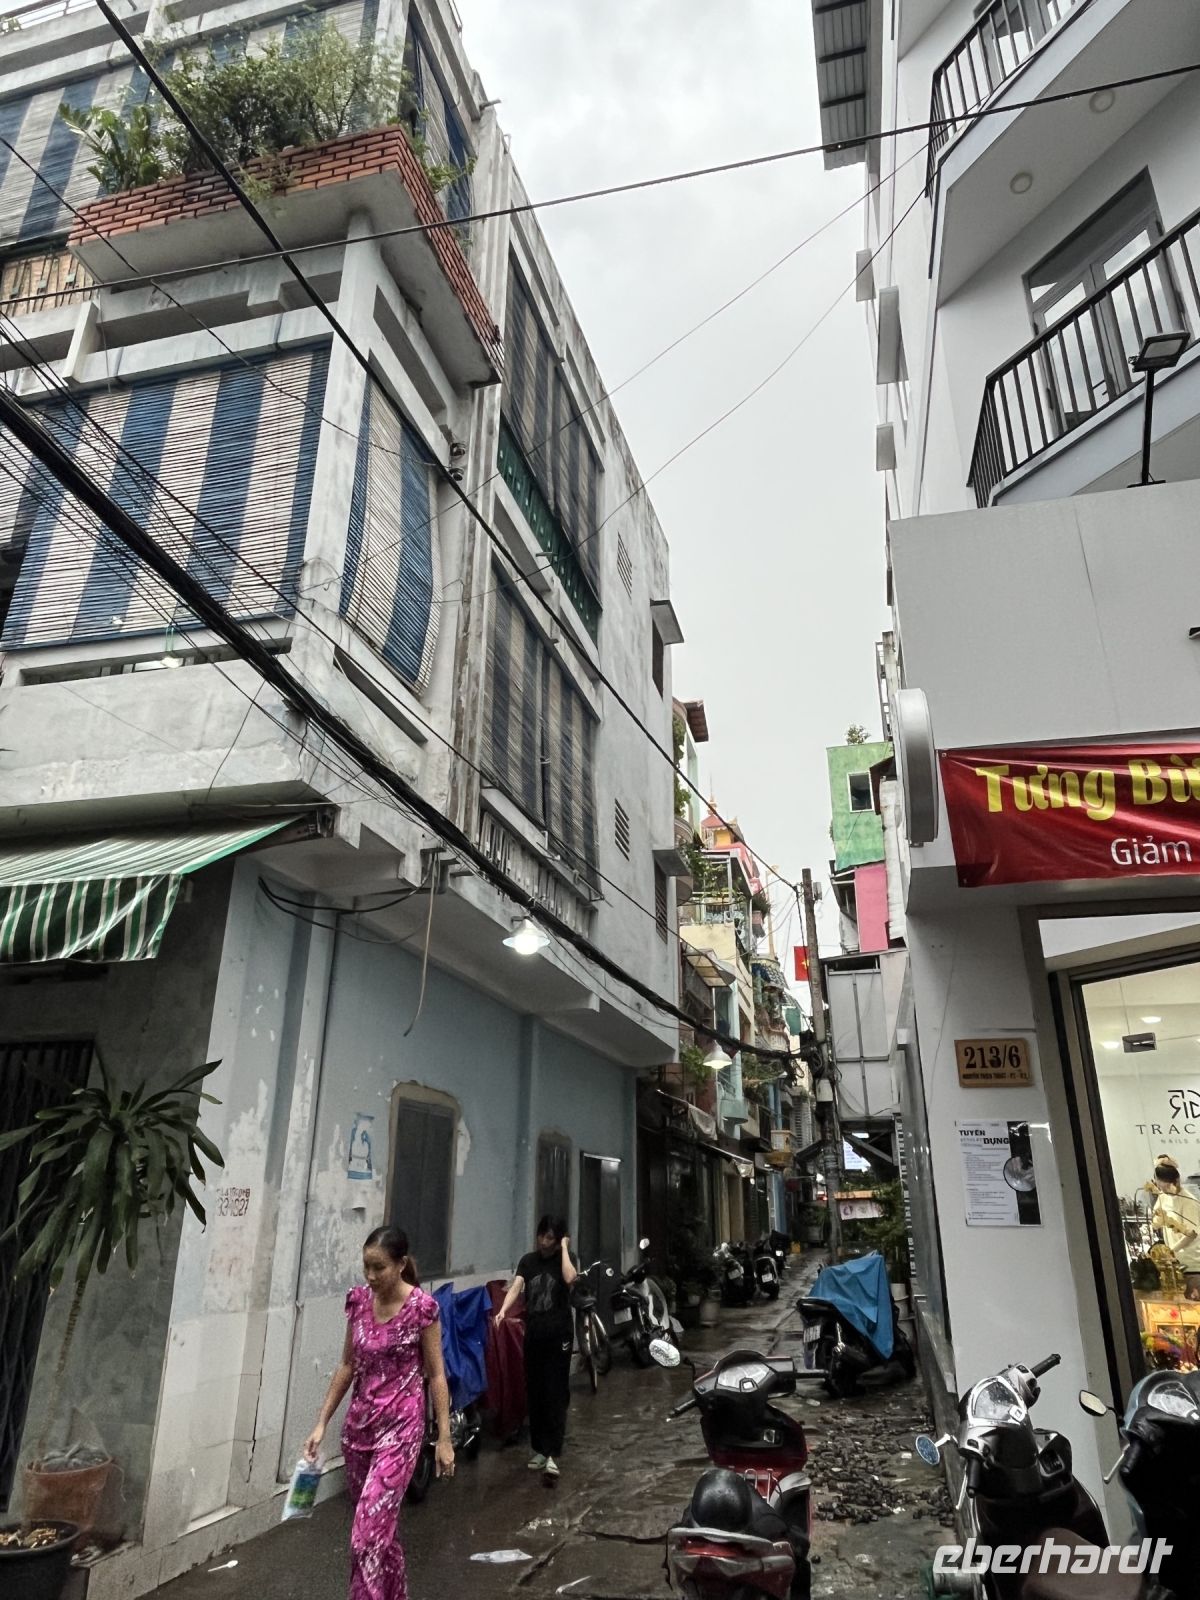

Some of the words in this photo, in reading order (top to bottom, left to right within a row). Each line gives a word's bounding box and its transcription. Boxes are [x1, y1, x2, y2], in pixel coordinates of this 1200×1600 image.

[975, 764, 1116, 821] Tưng
[1111, 835, 1192, 866] Giảm
[964, 1044, 1021, 1069] 213/6
